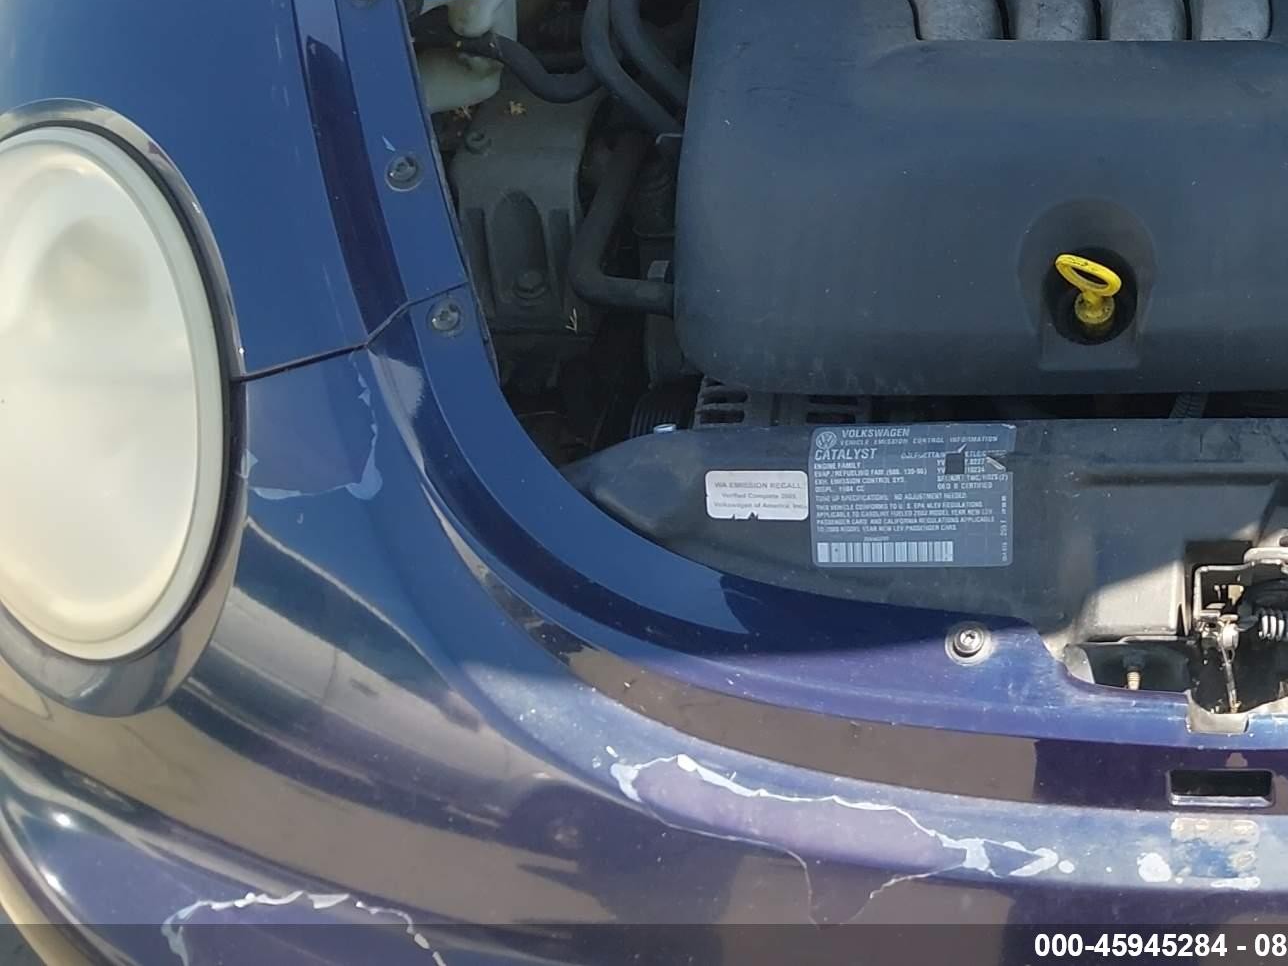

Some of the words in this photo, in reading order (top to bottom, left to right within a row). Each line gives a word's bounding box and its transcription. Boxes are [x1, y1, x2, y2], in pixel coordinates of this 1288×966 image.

[842, 428, 911, 438] VOLKSWAGEN
[840, 438, 869, 446] VEHICLE
[814, 447, 878, 461] CATALYST
